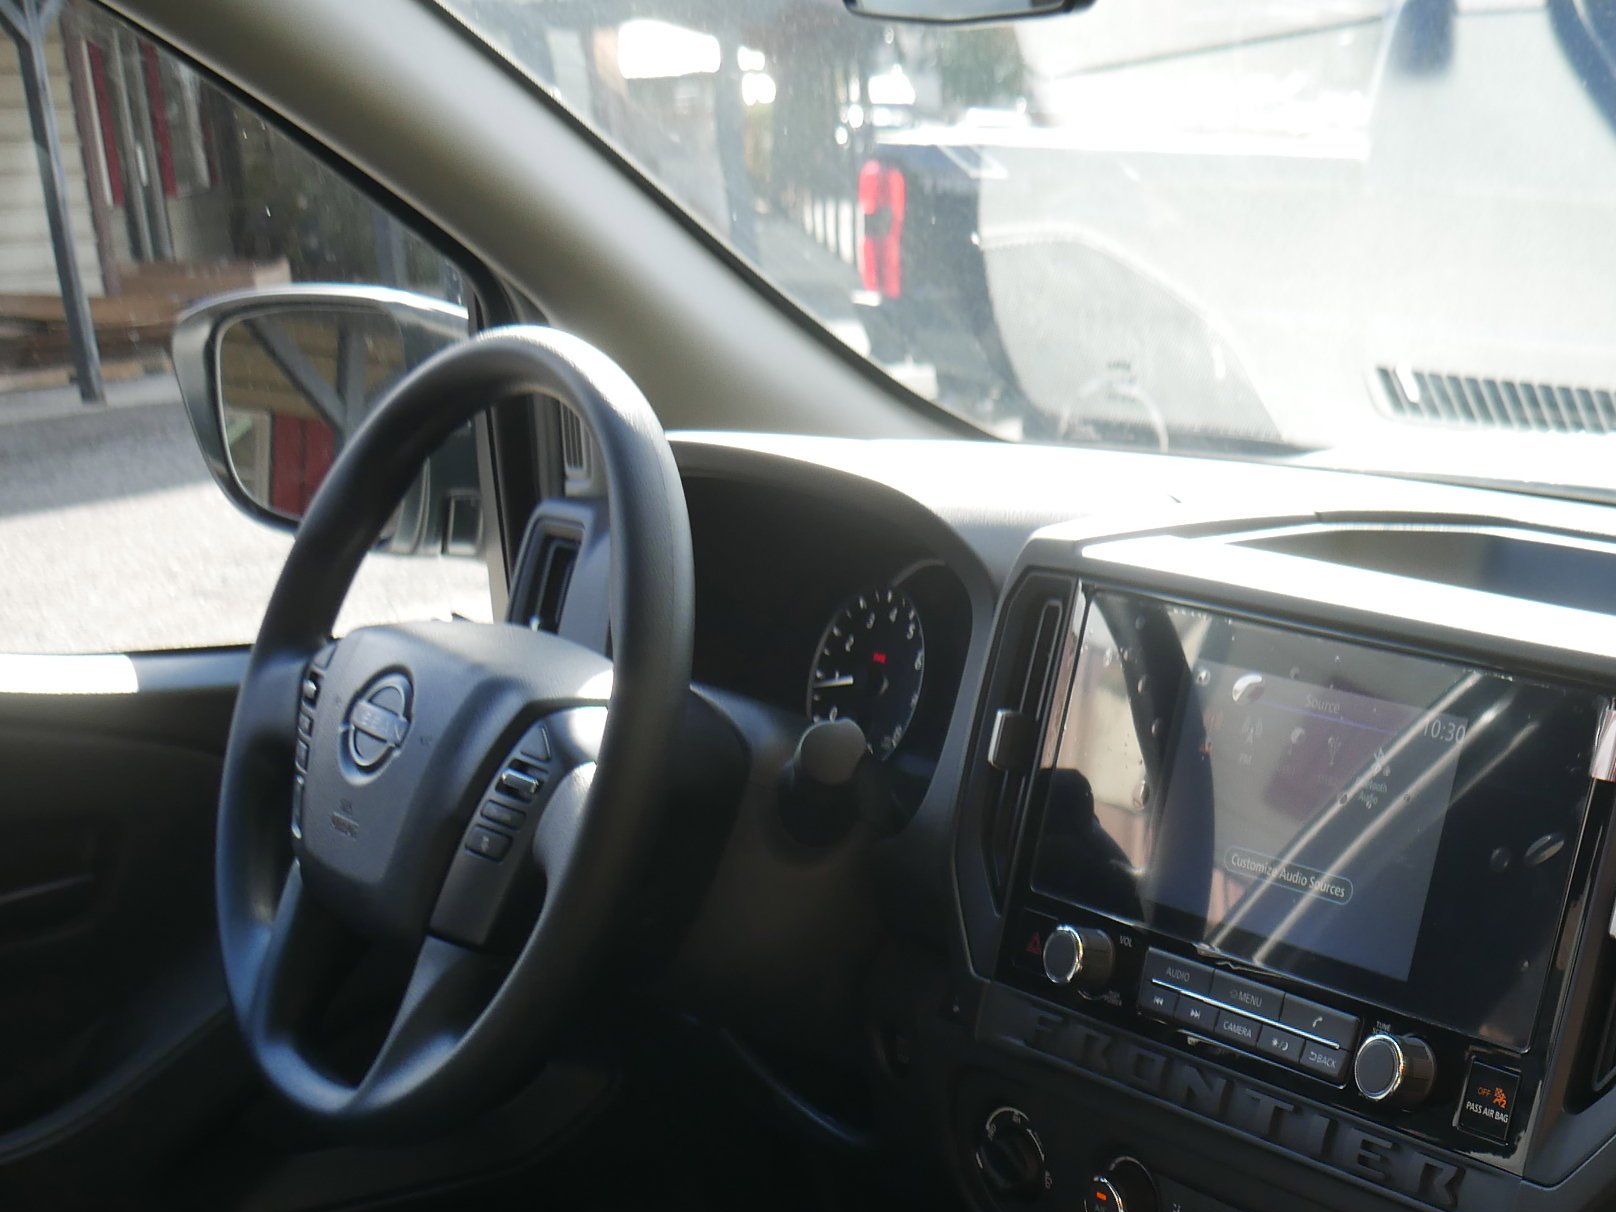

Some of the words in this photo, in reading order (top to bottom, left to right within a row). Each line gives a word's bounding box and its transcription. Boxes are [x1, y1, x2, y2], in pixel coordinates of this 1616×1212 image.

[1305, 694, 1341, 714] Source
[1423, 717, 1466, 744] 10:30
[1230, 854, 1278, 878] Customize
[1279, 868, 1308, 887] Audio
[1309, 875, 1346, 898] Sources
[1119, 935, 1133, 948] VOL
[1165, 966, 1190, 983] AUDIO
[1238, 991, 1263, 1008] MENU
[1223, 1020, 1253, 1038] CAMERA
[1316, 1053, 1337, 1069] BACK
[1477, 1086, 1493, 1097] OFF
[1028, 1009, 1467, 1211] FRONTIER
[1465, 1100, 1484, 1115] PASS
[1483, 1106, 1496, 1119] AIR
[1494, 1109, 1509, 1124] BAG
